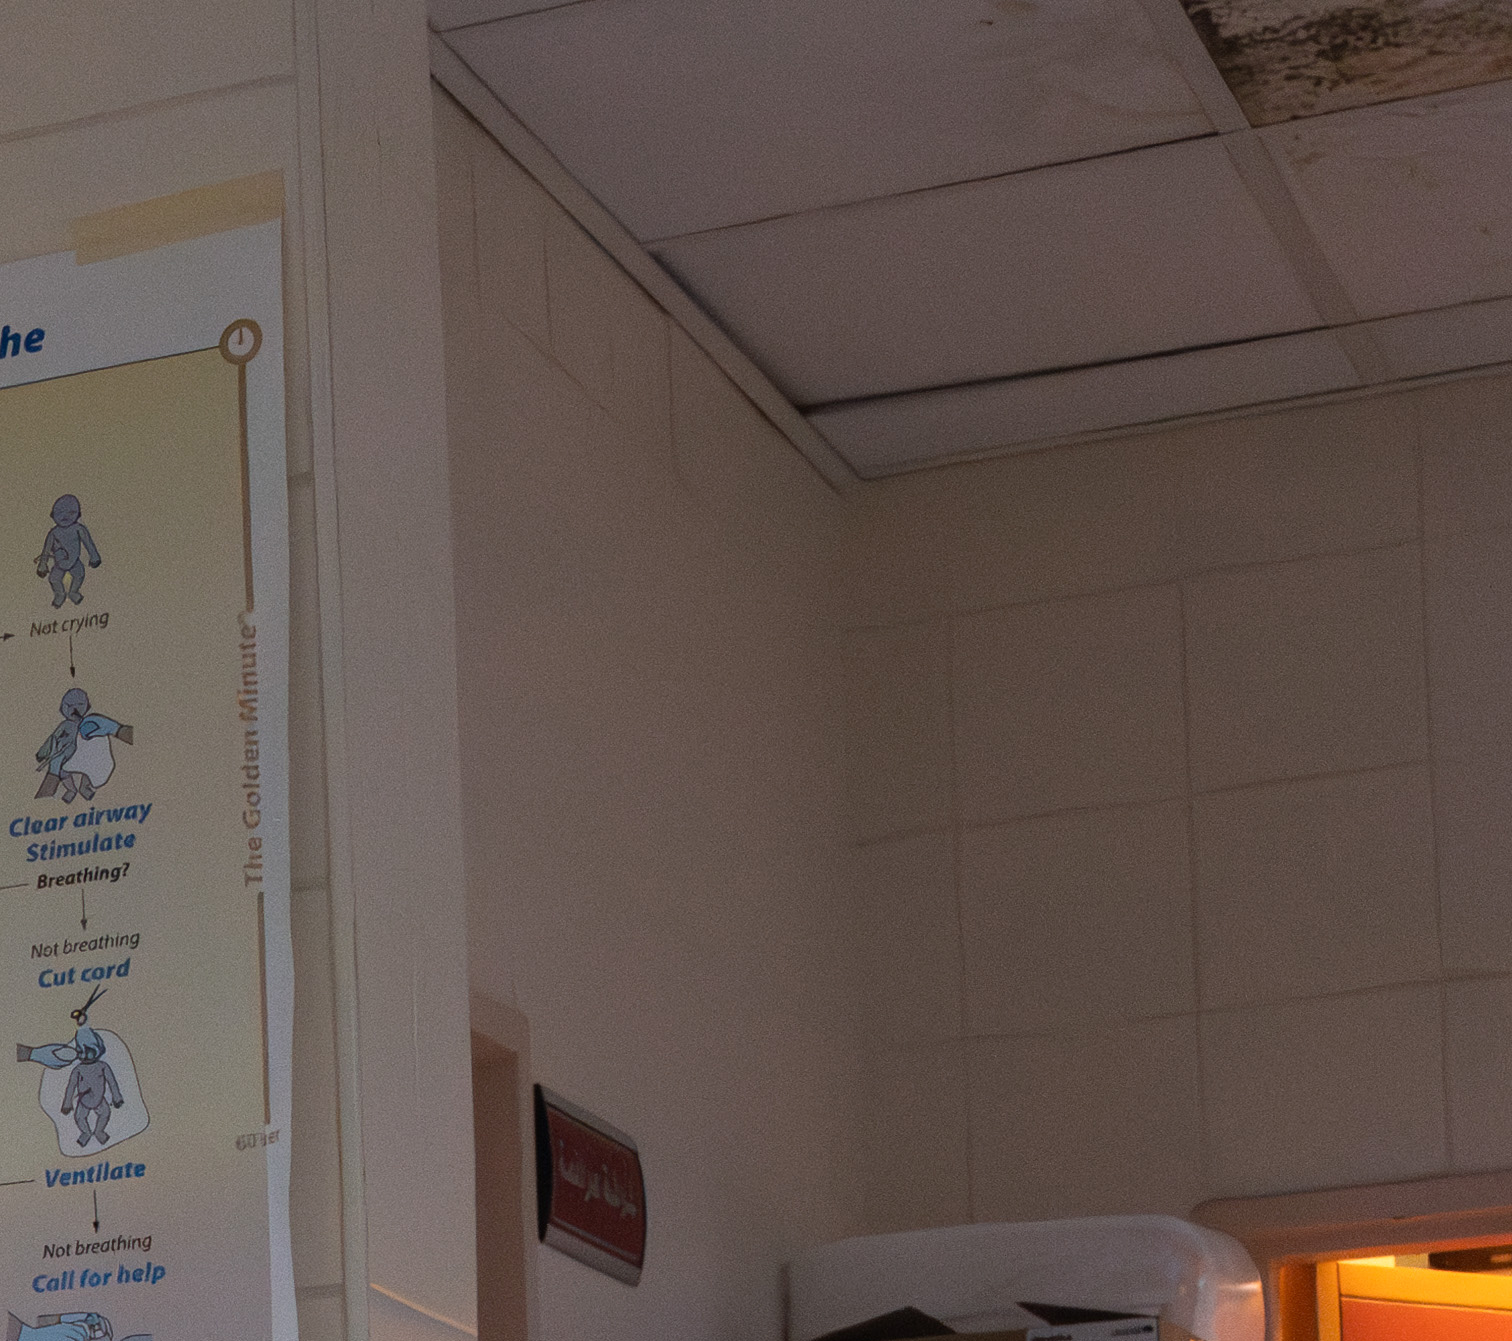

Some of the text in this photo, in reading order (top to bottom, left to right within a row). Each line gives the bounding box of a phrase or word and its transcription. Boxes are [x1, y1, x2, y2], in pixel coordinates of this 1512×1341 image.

[28, 608, 111, 639] Not crying
[240, 730, 262, 830] Golden
[8, 802, 153, 838] Clear airway
[25, 832, 137, 863] Stimulate
[244, 835, 264, 888] The
[36, 862, 131, 890] Breathing?
[30, 932, 141, 960] Not breathing
[38, 956, 132, 989] Cut cord
[44, 1160, 147, 1189] Ventilate
[41, 1234, 153, 1260] Not breathing
[31, 1259, 167, 1294] Call for help
